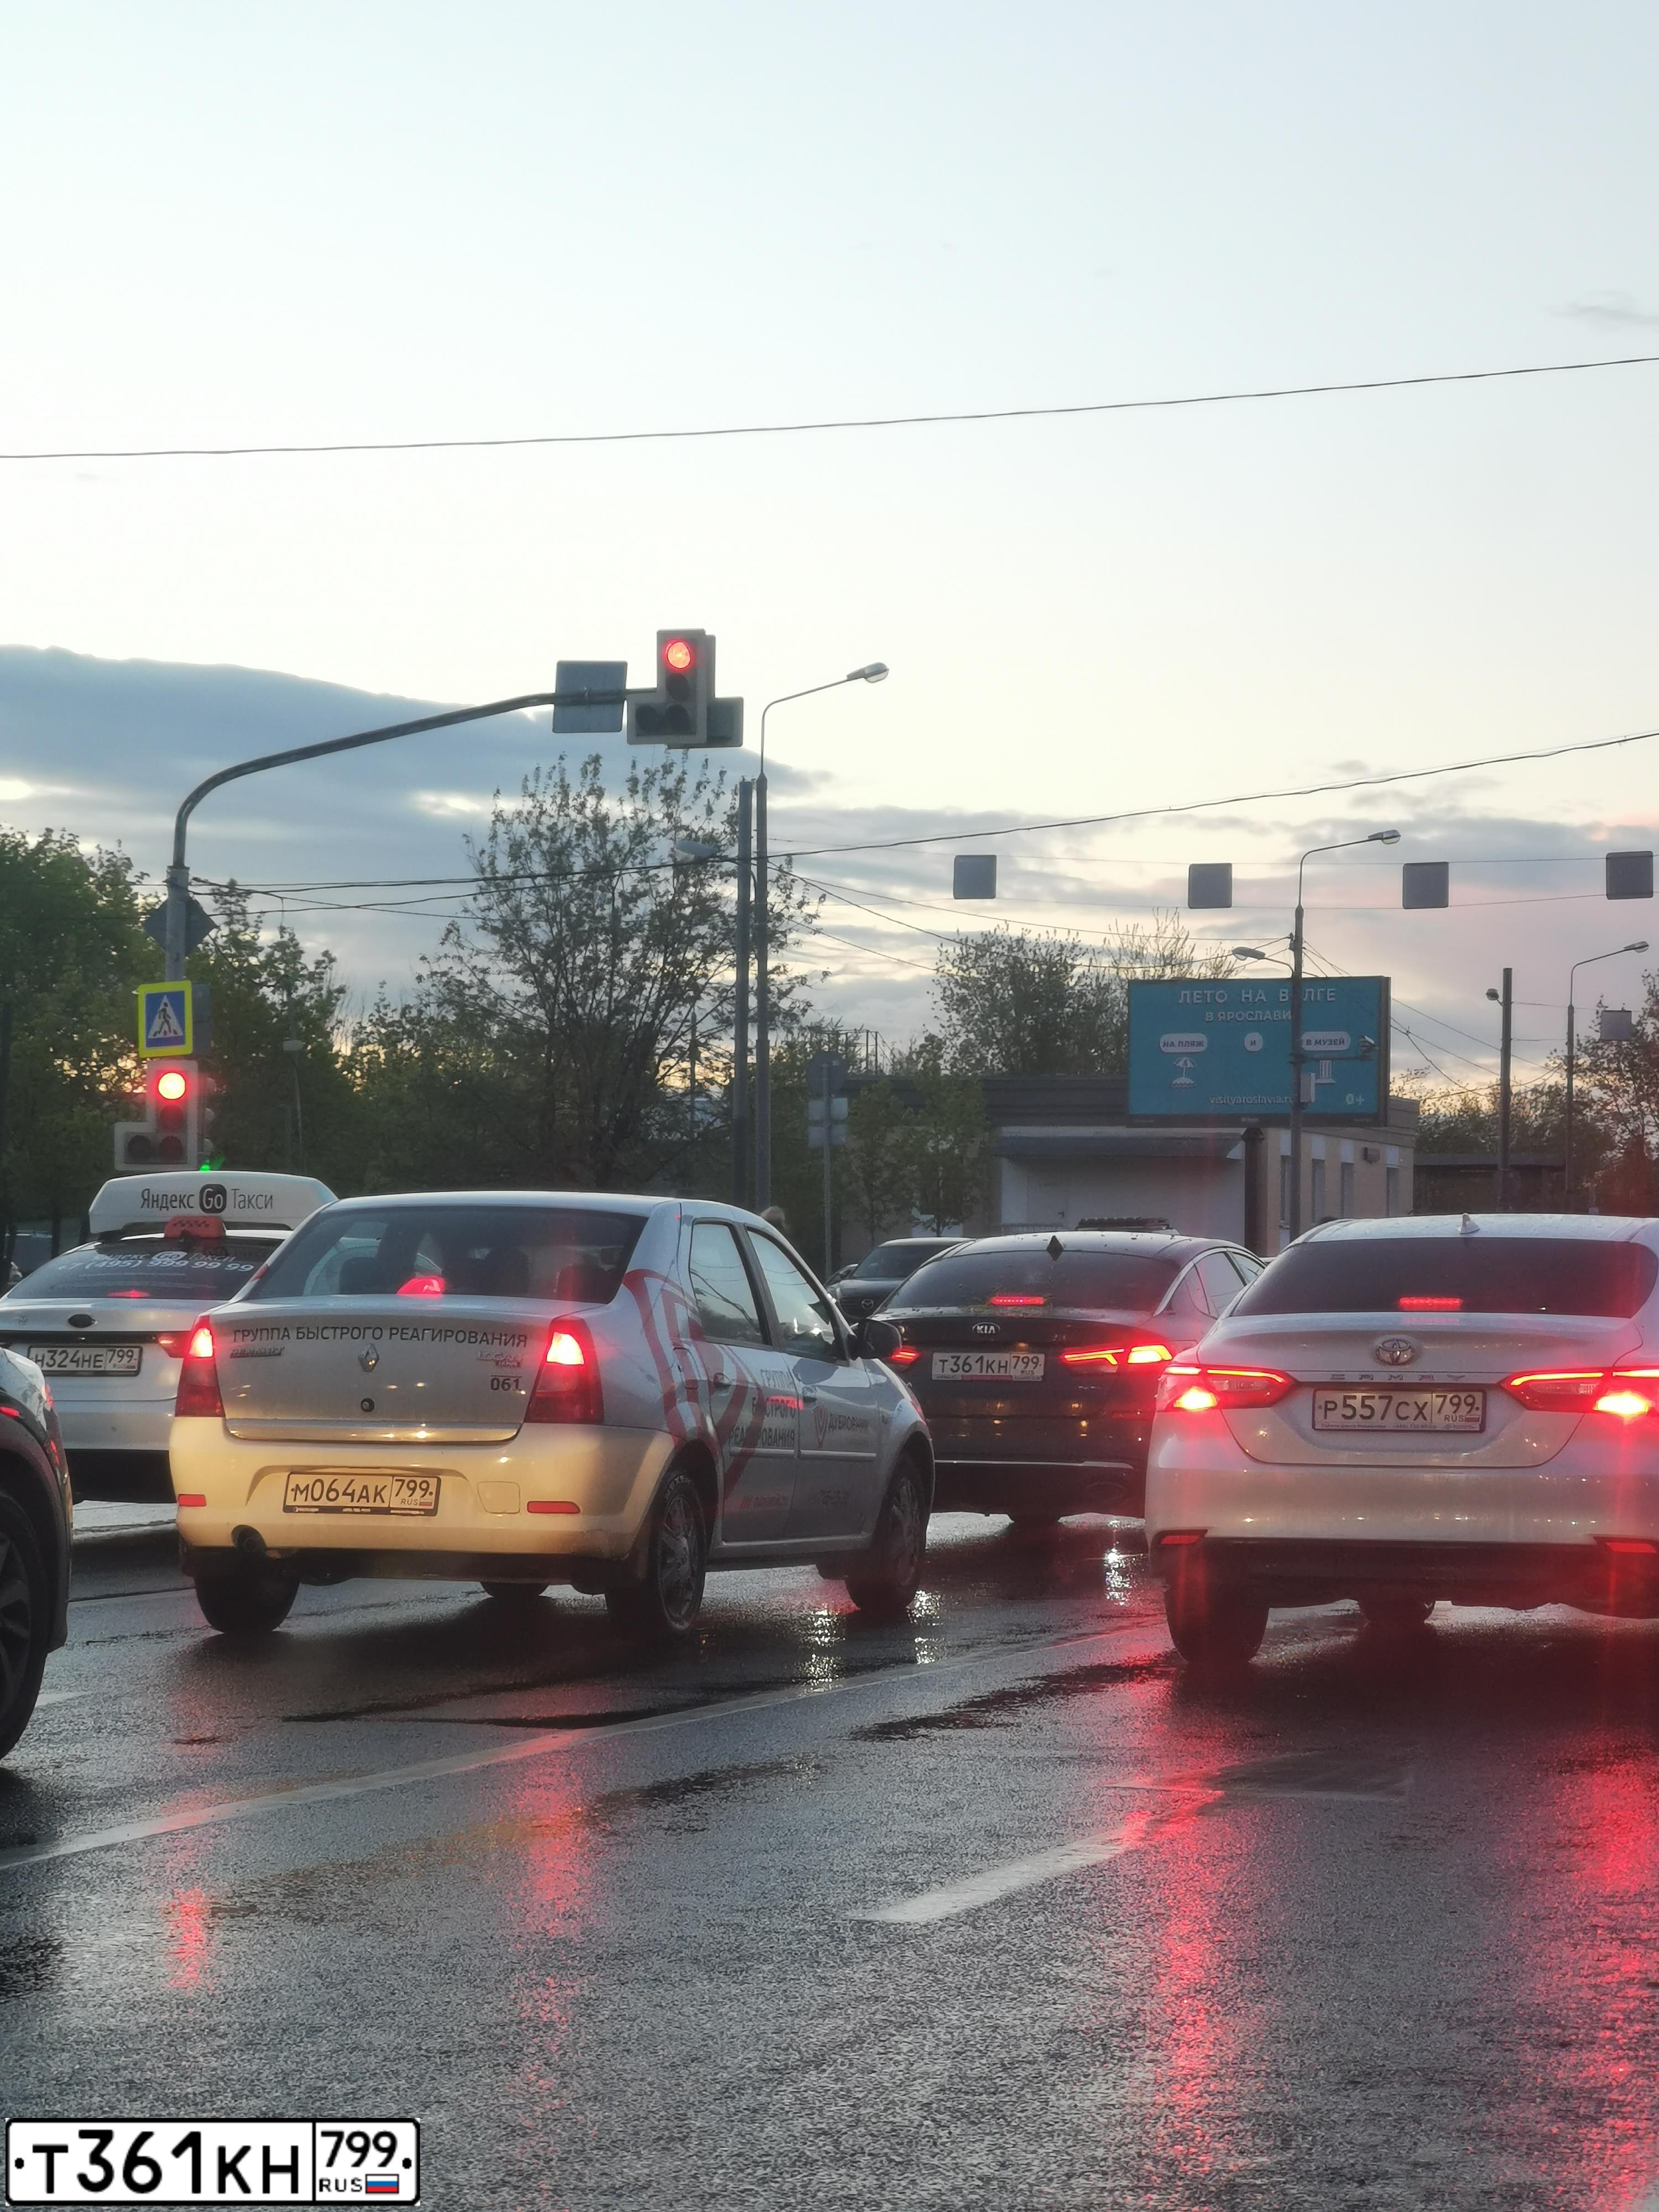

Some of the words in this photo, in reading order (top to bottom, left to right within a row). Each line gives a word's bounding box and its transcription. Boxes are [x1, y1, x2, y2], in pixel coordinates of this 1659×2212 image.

[1178, 990, 1228, 1004] ЛЕТО
[1241, 989, 1267, 1002] НА
[1279, 988, 1337, 1002] ВЛГЕ
[1205, 1011, 1214, 1022] В
[1162, 1039, 1175, 1048] НА
[1177, 1039, 1205, 1048] ПЛЯЖ
[1314, 1037, 1345, 1046] МУЗЕЙ
[1345, 1093, 1365, 1105] 0+
[140, 1188, 195, 1211] Яндекс
[202, 1188, 224, 1210] Go
[230, 1188, 273, 1209] Такси
[85, 1259, 143, 1269] (495)
[147, 1259, 189, 1267] 999
[191, 1260, 222, 1269] 99
[225, 1262, 254, 1272] 99
[976, 1325, 996, 1334] KIA
[233, 1327, 290, 1343] ГРУППА
[296, 1326, 383, 1340] БЫСТРОГО
[389, 1327, 528, 1348] РЕАГИРОВАНИЯ
[34, 1349, 103, 1369] Н324НЕ
[108, 1349, 134, 1363] 799
[938, 1355, 1008, 1374] Т361КН
[1012, 1355, 1040, 1370] 799
[490, 1378, 521, 1391] 061
[1323, 1394, 1429, 1421] Р557СХ
[1434, 1394, 1476, 1414] 799
[1444, 1414, 1465, 1423] RUS
[293, 1478, 388, 1504] М064АК
[395, 1479, 430, 1498] 799
[400, 1498, 419, 1506] RUS
